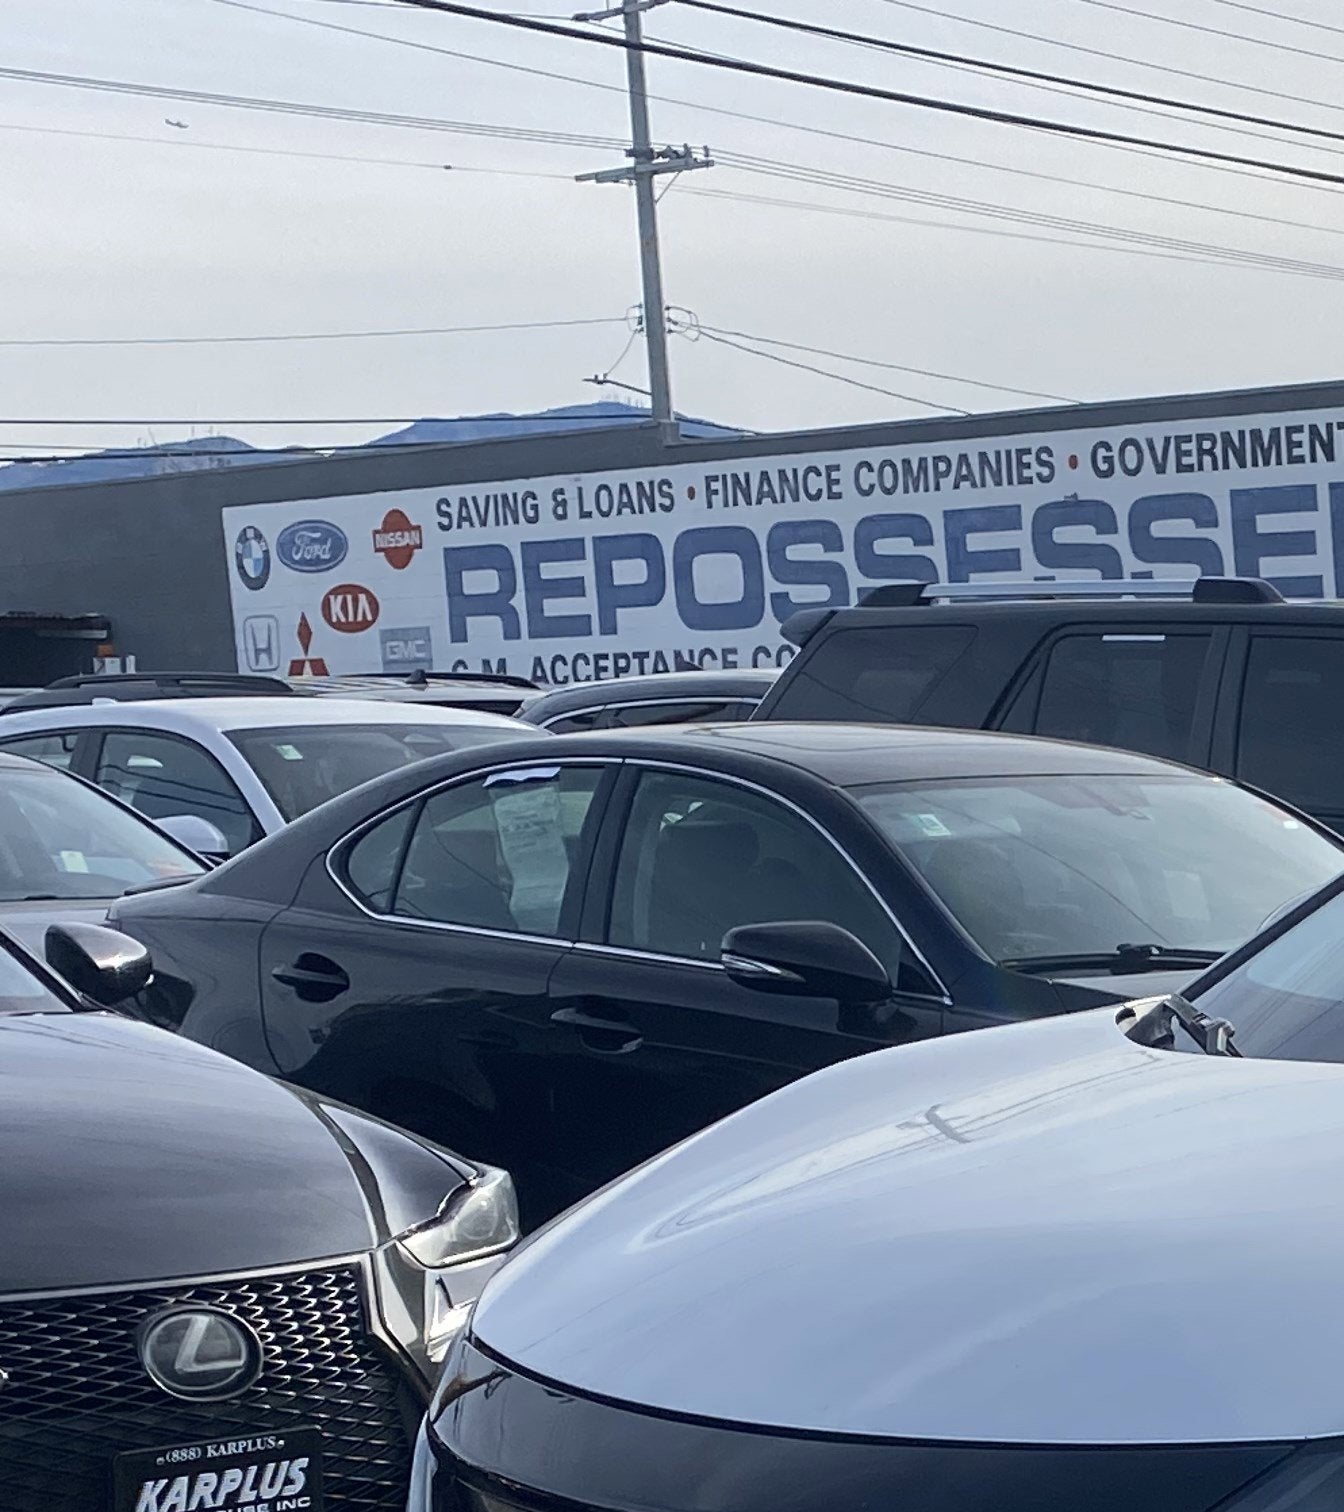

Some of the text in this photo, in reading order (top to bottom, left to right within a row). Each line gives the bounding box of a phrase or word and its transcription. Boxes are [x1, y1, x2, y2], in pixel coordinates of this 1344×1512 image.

[436, 489, 540, 531] SAVING
[551, 488, 568, 521] &
[578, 479, 675, 520] LOANS
[704, 463, 843, 510] FINANCE
[853, 445, 1056, 497] COMPANIES
[291, 530, 331, 561] Ford
[375, 531, 422, 548] NISSAN
[329, 593, 373, 623] KIA
[165, 1436, 277, 1464] (888) KARPLUS
[276, 1496, 312, 1512] INC
